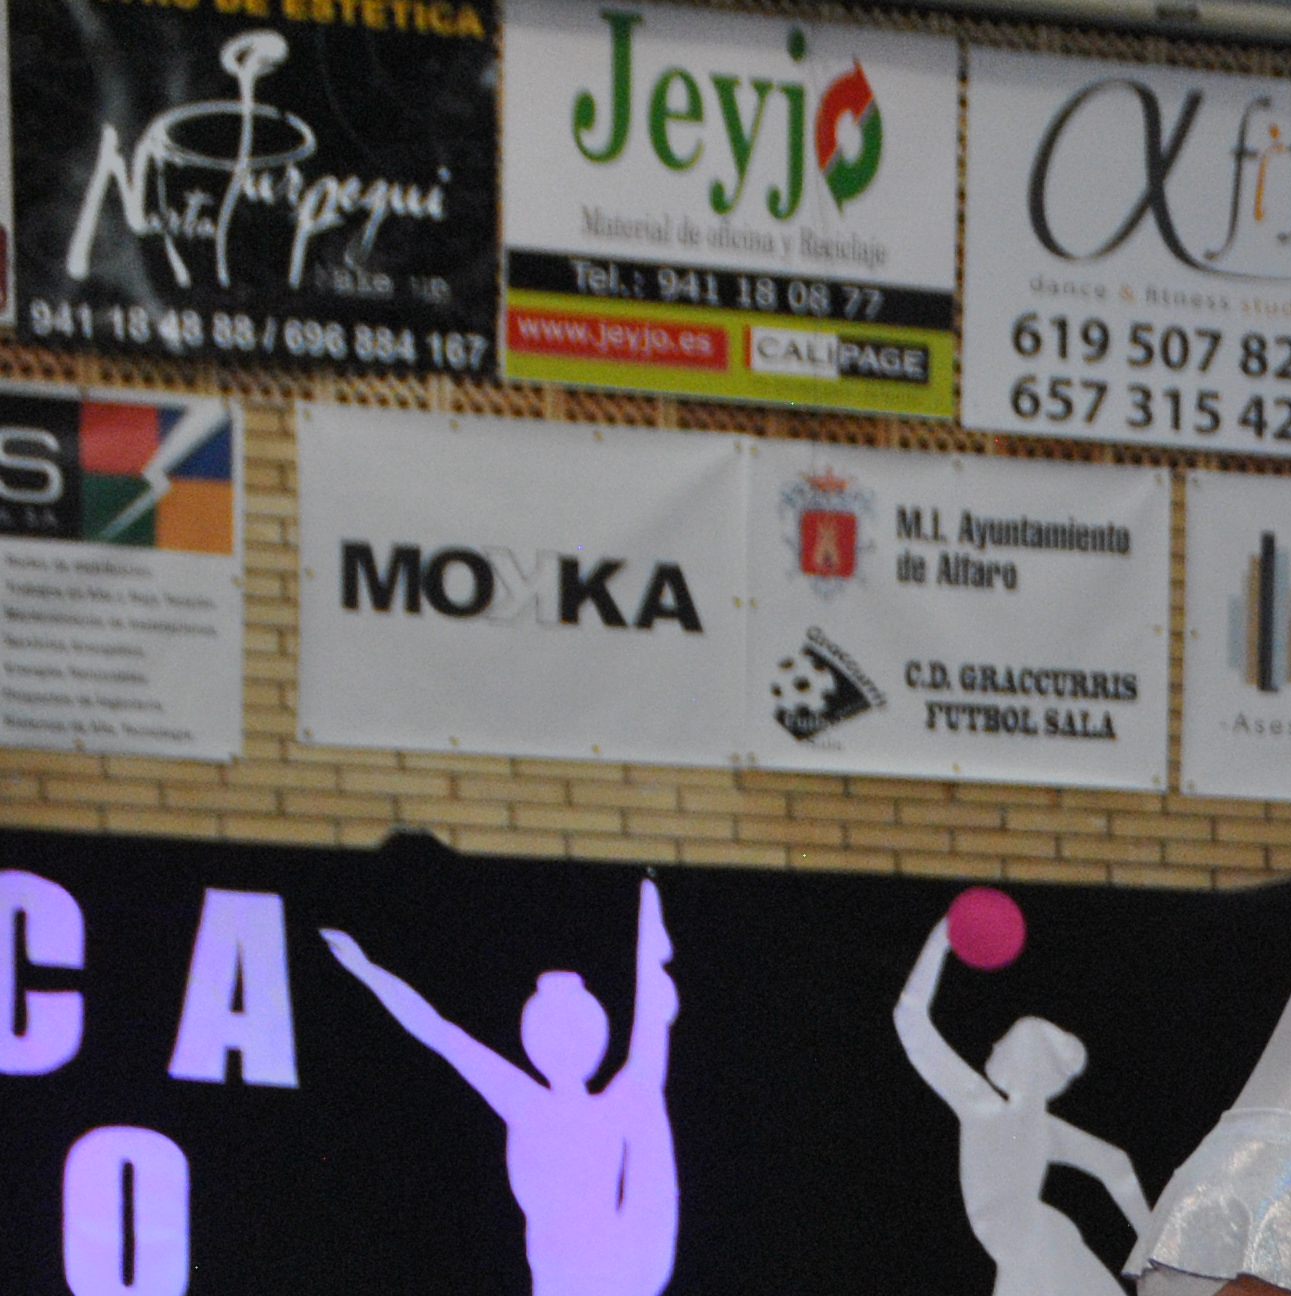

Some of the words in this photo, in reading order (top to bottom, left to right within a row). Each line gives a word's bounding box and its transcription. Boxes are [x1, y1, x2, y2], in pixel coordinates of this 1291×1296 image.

[572, 8, 884, 221] Jeyjo
[580, 205, 672, 243] Material
[677, 215, 700, 246] de
[705, 218, 776, 254] oficina
[799, 226, 888, 270] Reciclaje
[657, 268, 719, 307] 941
[737, 276, 778, 311] 18
[787, 282, 830, 317] 08
[842, 286, 885, 319] 77
[1029, 275, 1107, 299] dance
[29, 298, 94, 339] 941
[106, 303, 150, 343] 18
[212, 311, 256, 350] 88
[283, 318, 347, 360] 696
[354, 323, 416, 365] 884
[426, 331, 488, 371] 167
[517, 315, 714, 357] www.jeyjo.es
[1012, 312, 1110, 364] 619
[1126, 323, 1222, 372] 507
[1010, 374, 1108, 422] 657
[1126, 384, 1222, 434] 315
[958, 508, 1131, 556] Ayuntamiento
[897, 549, 927, 584] de
[936, 550, 1018, 590] Alfaro
[903, 659, 952, 691] C.D.
[958, 664, 1139, 701] GRACCURRIS
[925, 700, 1038, 735] FUTBOL
[1044, 706, 1117, 740] SALA
